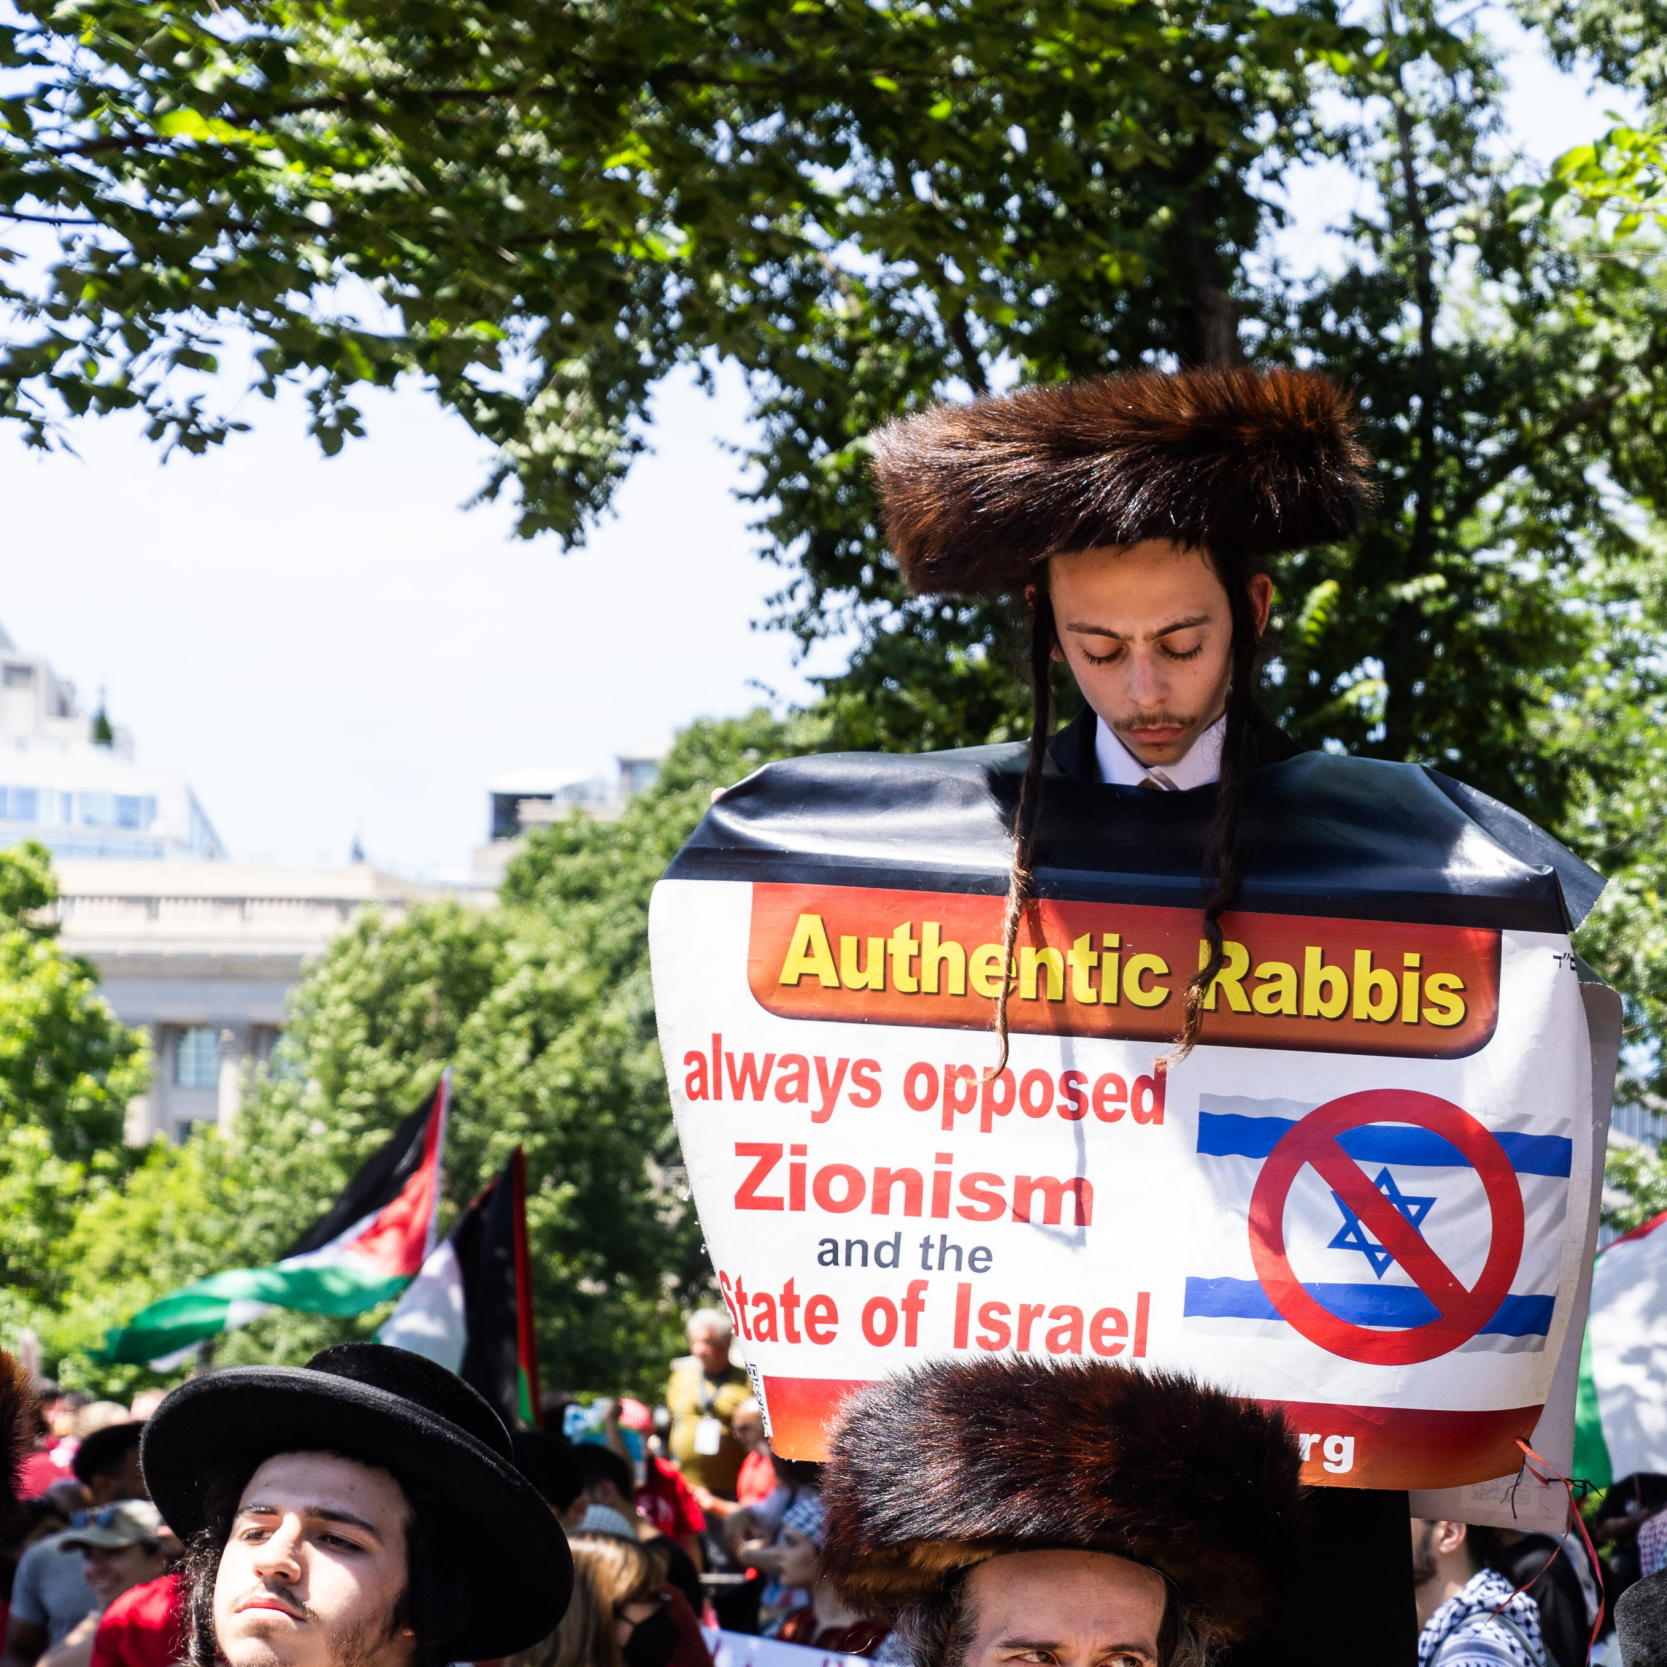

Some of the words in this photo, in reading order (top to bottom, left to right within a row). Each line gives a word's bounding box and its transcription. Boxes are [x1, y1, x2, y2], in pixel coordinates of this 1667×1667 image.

[779, 914, 1170, 1007] Authentic
[1199, 939, 1468, 1027] Rabbis
[683, 1032, 882, 1124] always
[903, 1058, 1168, 1133] opposed
[734, 1141, 1094, 1227] Zionism
[817, 1231, 901, 1268] and
[920, 1234, 993, 1273] the
[719, 1270, 839, 1345] State
[861, 1279, 928, 1348] of
[954, 1282, 1151, 1358] Israel
